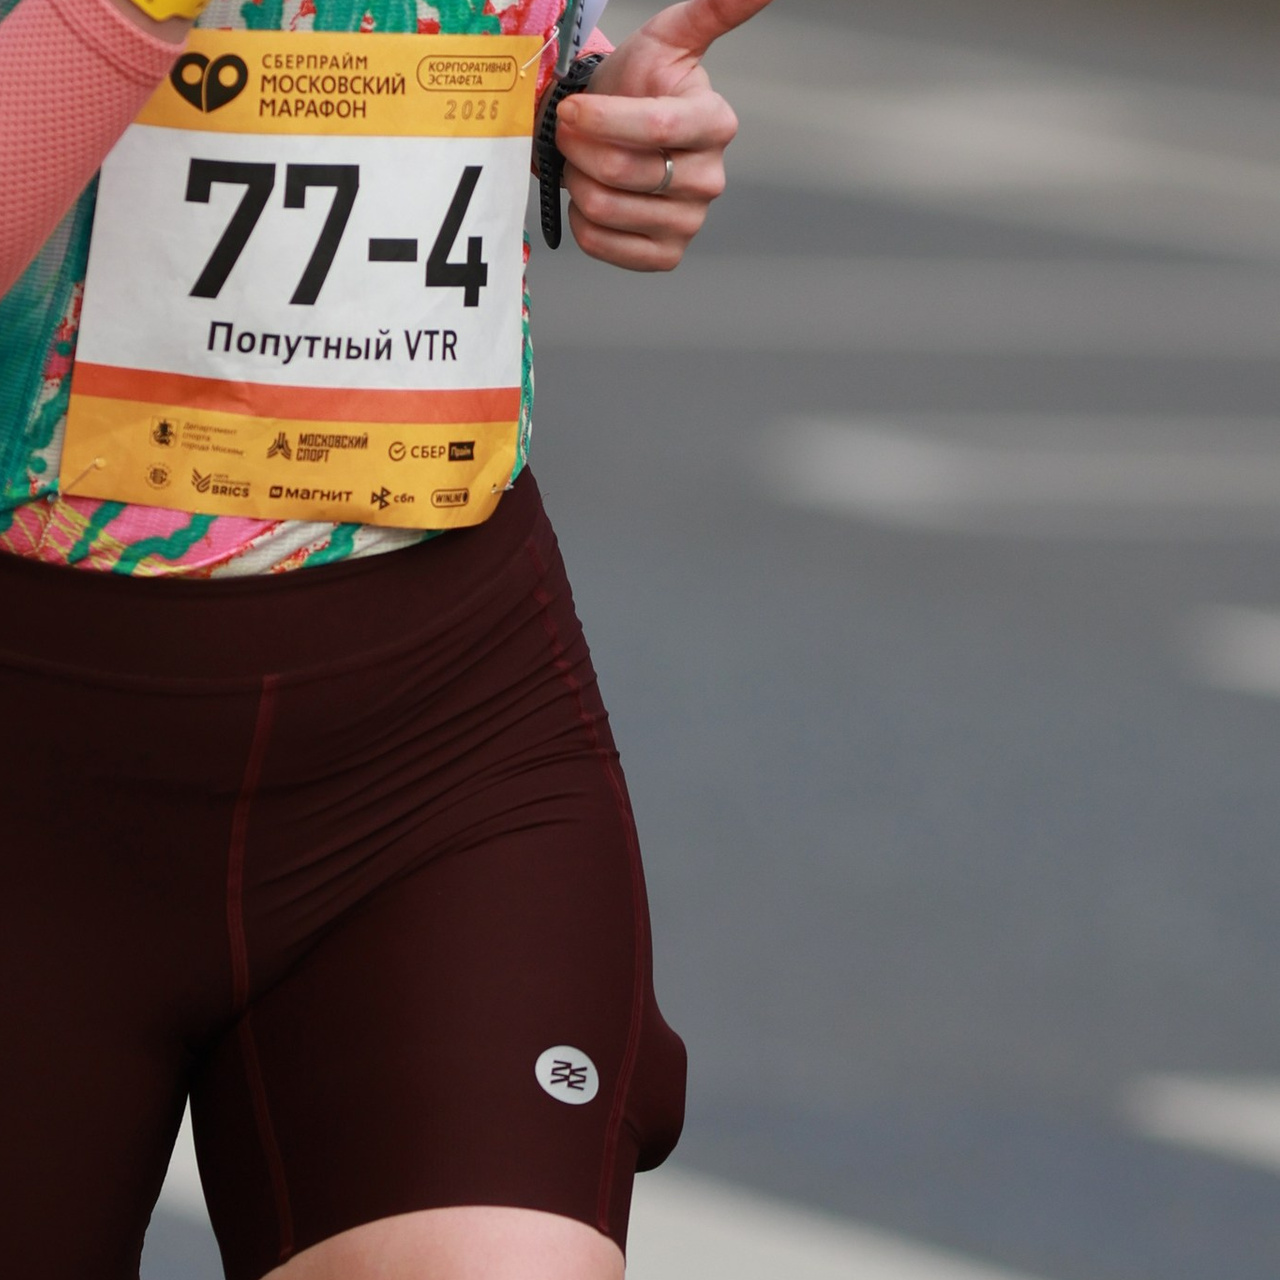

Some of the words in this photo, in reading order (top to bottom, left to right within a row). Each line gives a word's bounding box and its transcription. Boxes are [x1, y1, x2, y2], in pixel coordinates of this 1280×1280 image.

[261, 52, 368, 70] СБЕРПРАЙМ
[428, 61, 512, 73] КОРПОРАТИВНАЯ
[260, 73, 406, 95] МОСКОВСКИЙ
[428, 74, 483, 86] ЭСТАФЕТА
[259, 99, 367, 118] МАРАФОН
[444, 99, 500, 120] 2026
[185, 158, 488, 307] 77-4
[207, 321, 393, 365] Попутный
[404, 329, 458, 361] VTR
[298, 432, 368, 449] МОСКОВСКИЙ
[296, 447, 330, 463] СПОРТ
[410, 445, 446, 458] СБЕР
[211, 484, 250, 497] BRICS
[393, 493, 415, 503] сбп
